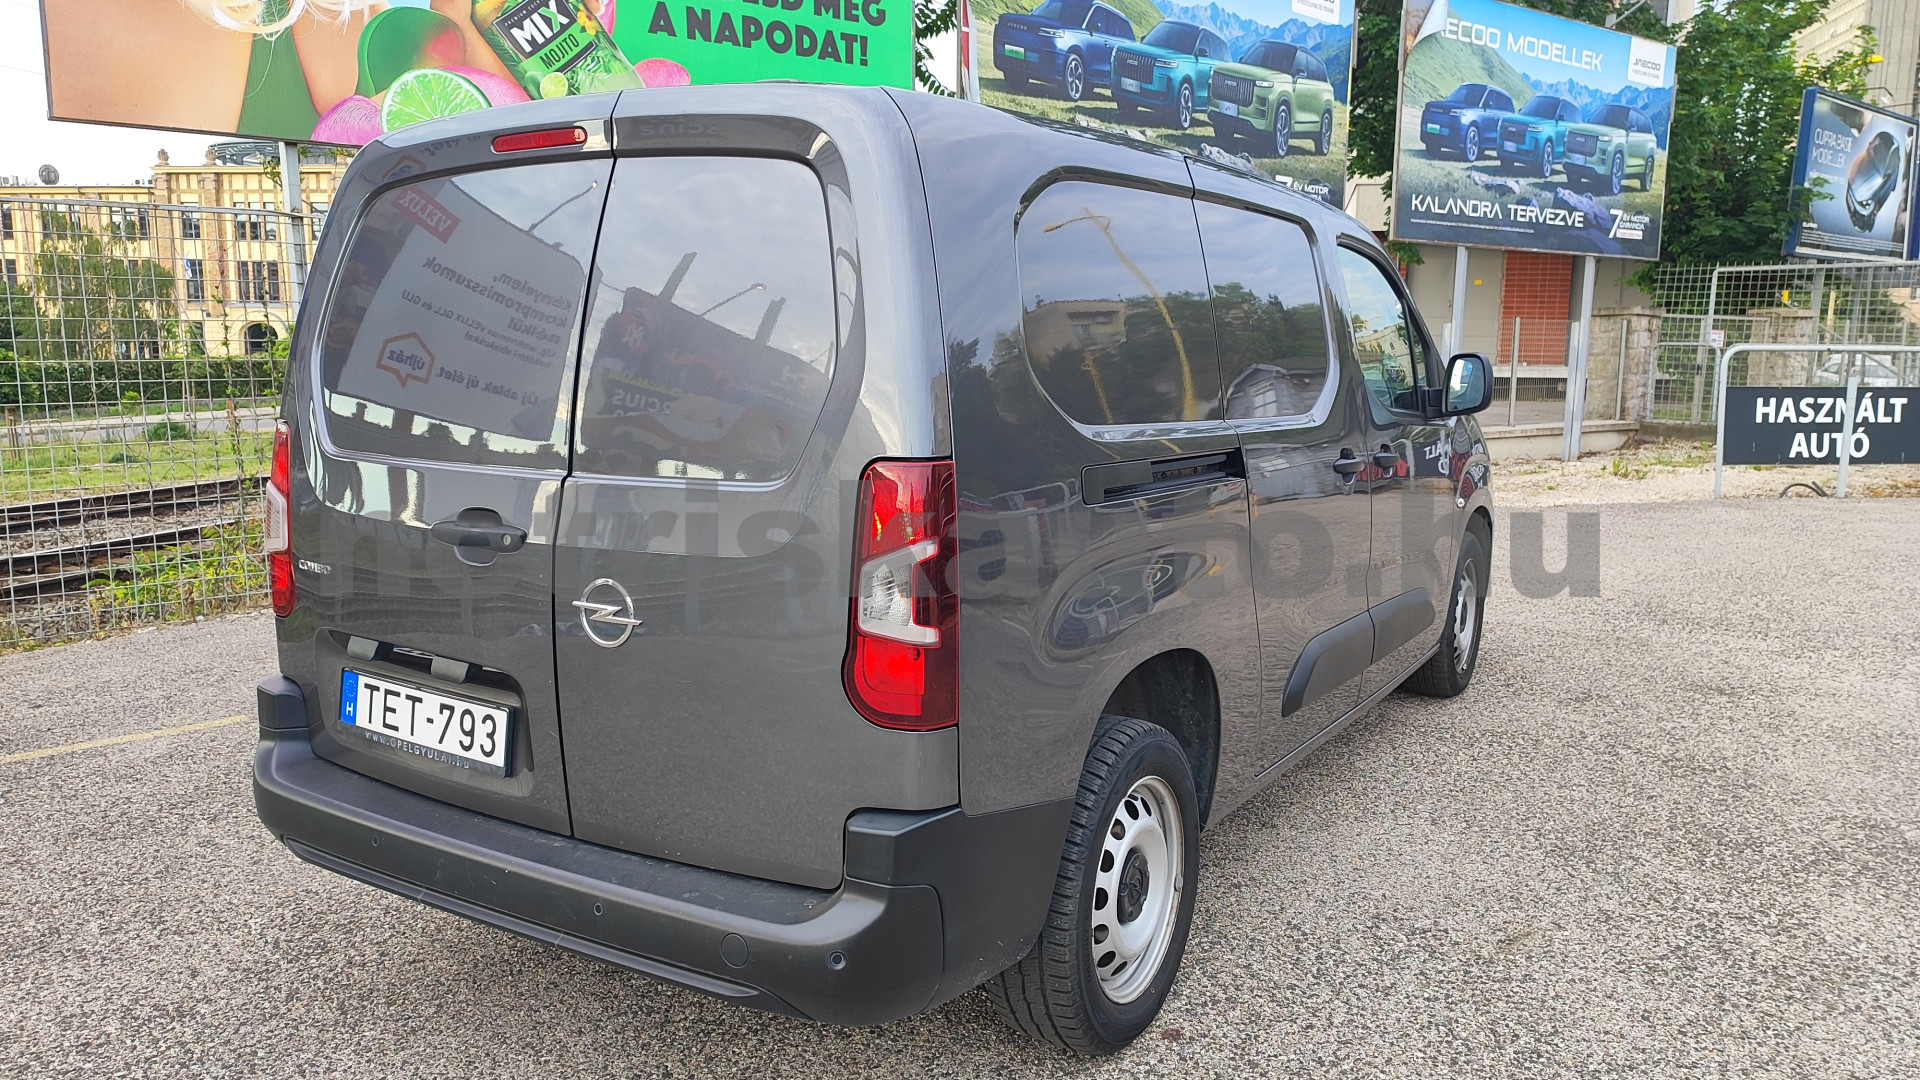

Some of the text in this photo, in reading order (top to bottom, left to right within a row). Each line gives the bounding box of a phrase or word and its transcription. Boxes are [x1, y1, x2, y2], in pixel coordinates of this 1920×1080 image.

[509, 0, 571, 53] MIX
[813, 0, 887, 27] MEG
[539, 33, 580, 70] MOJITO
[647, 1, 869, 67] A NAPODAT!
[1440, 17, 1604, 72] ECOO MODELLEK
[1304, 184, 1329, 195] MOTOR
[1410, 193, 1503, 220] KALANDRA
[1507, 204, 1585, 228] TERVEZVE
[1608, 208, 1623, 239] 7
[345, 682, 497, 758] H TET-793
